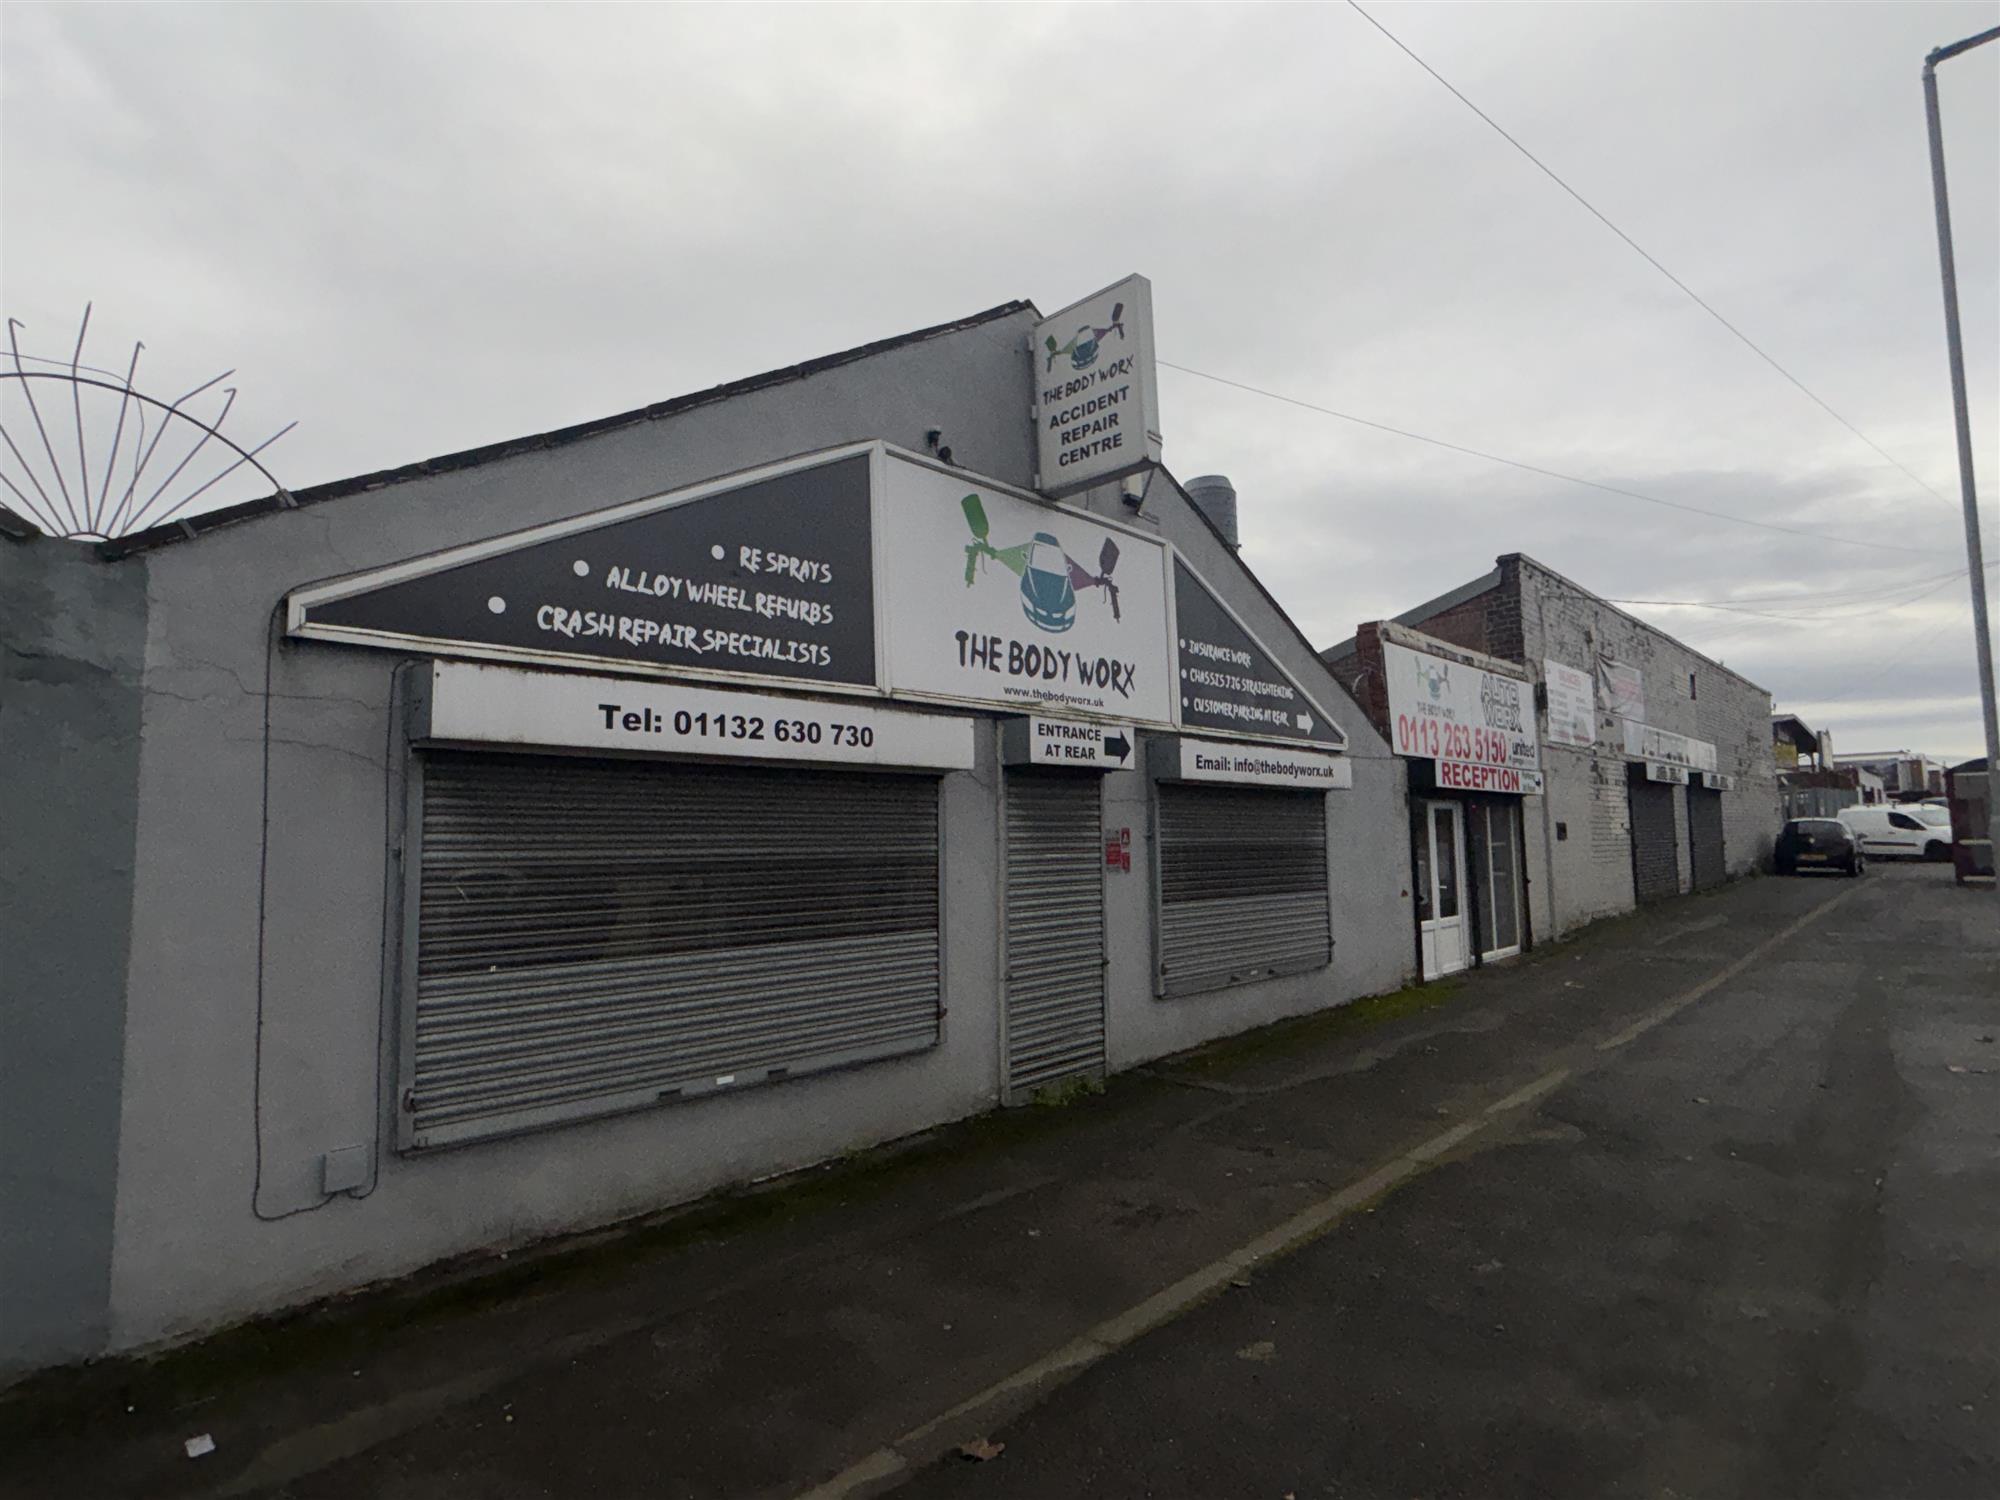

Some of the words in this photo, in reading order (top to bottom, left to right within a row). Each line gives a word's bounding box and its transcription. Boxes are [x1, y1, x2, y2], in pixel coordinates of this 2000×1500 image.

[1043, 385, 1063, 405] THE
[1065, 374, 1096, 398] BODY
[1099, 355, 1134, 382] WORX
[1050, 385, 1130, 429] ACCIDENT
[1061, 413, 1119, 445] REPAIR
[1059, 433, 1123, 467] CENTRE
[740, 545, 761, 574] RE
[766, 551, 832, 584] SPRAYS
[606, 566, 682, 599] ALLOY
[687, 580, 753, 612] WHEEL
[755, 592, 834, 626] REFURBS
[537, 605, 615, 638] CRASH
[618, 616, 702, 654] REPAIR
[702, 629, 831, 666] SPECIALISTS
[955, 630, 1002, 673] THE
[1008, 640, 1071, 682] BODY
[1076, 653, 1135, 699] WORX
[1188, 640, 1231, 662] INSURANCE
[1231, 650, 1252, 669] WORK
[1003, 686, 1104, 708] www.thebodyworx.uk
[1190, 668, 1224, 688] CHASSIS
[1225, 676, 1241, 691] JIG
[1241, 679, 1294, 700] STRAIGHTENING
[598, 704, 662, 733] Tel:
[674, 710, 764, 740] 01132
[774, 719, 822, 744] 630
[830, 724, 874, 748] 730
[1194, 698, 1234, 719] CUSTOMER
[1234, 706, 1263, 721] PARKING
[1272, 710, 1290, 727] REAR
[1038, 723, 1101, 741] ENTRANCE
[1399, 713, 1439, 756] 0113
[1444, 722, 1471, 759] 263
[1475, 727, 1507, 765] 5150
[1045, 744, 1061, 757] AT
[1065, 746, 1096, 760] REAR
[1196, 754, 1231, 772] Email:
[1234, 758, 1334, 779] info@thebodyworx.uk
[1442, 762, 1520, 791] RECEPTION
